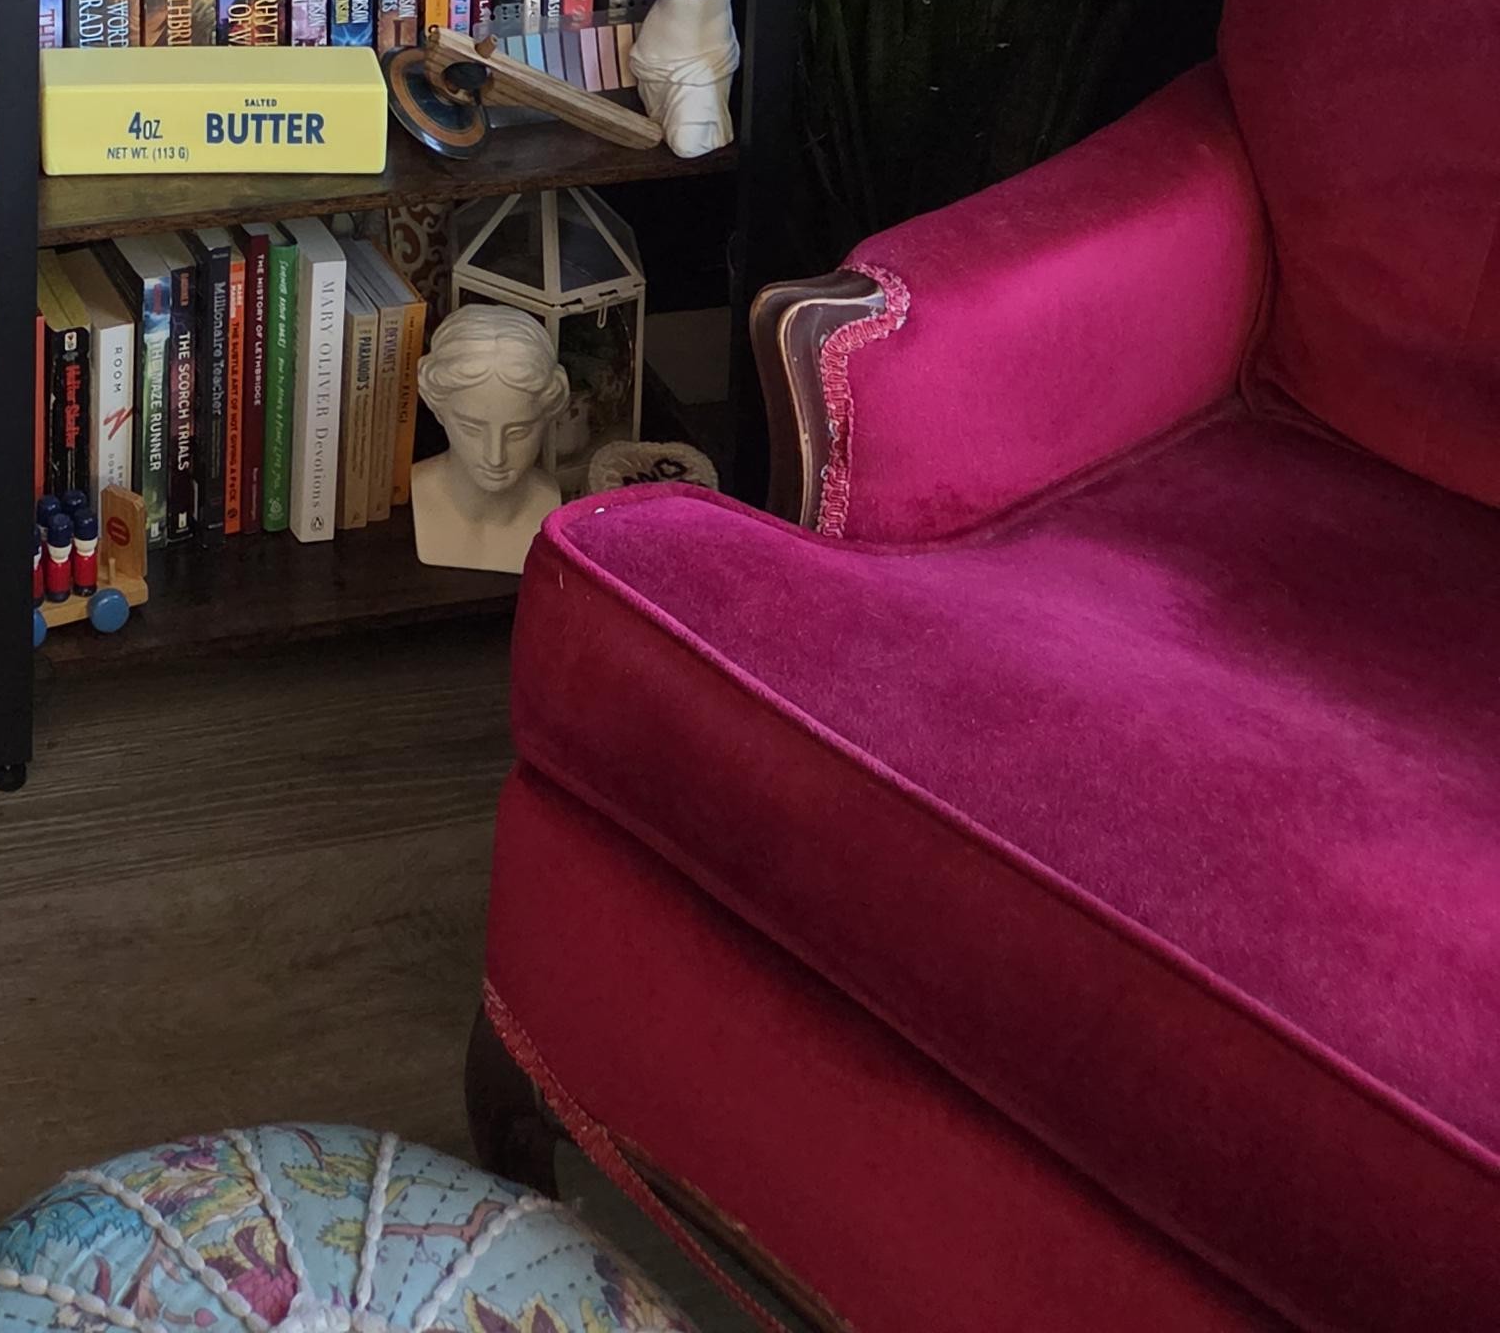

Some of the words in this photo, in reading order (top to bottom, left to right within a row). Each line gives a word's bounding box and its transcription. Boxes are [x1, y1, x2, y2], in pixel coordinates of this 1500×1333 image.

[244, 98, 277, 107] SALTED
[205, 113, 326, 145] BUTTER
[106, 147, 129, 161] NET
[131, 147, 149, 160] WT.
[152, 146, 176, 161] (113
[178, 147, 189, 162] G)
[320, 280, 337, 336] MARY
[150, 339, 162, 370] THE
[178, 331, 191, 360] THE
[150, 372, 162, 409] MAZE
[178, 363, 191, 420] SCORCH
[254, 344, 264, 405] LETHBRIDGE
[316, 340, 333, 428] OLIVER
[149, 412, 162, 471] RUNNER
[177, 423, 190, 471] TRIALS
[312, 429, 330, 510] Devotions
